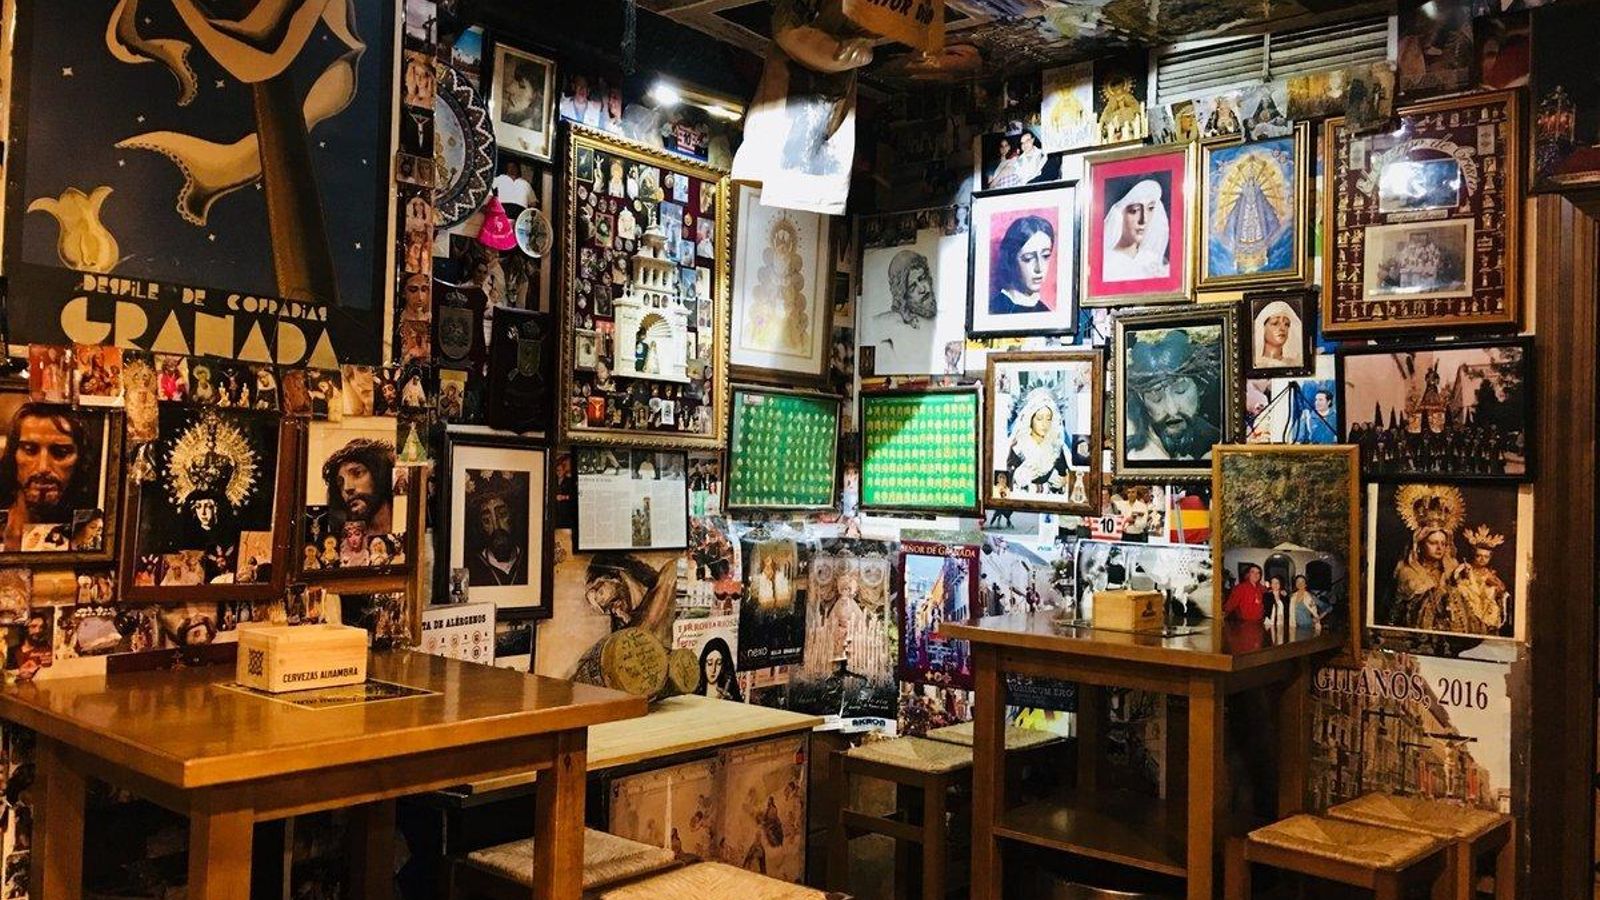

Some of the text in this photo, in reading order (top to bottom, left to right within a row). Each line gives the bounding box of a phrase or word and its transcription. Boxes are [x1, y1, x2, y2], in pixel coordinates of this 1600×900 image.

[182, 287, 206, 306] DE
[60, 296, 340, 370] GRANADA
[1100, 518, 1115, 534] 10
[926, 546, 937, 555] DE
[434, 619, 444, 630] DE
[283, 666, 359, 684] CERVEZAS ALHAMBRA
[1314, 666, 1488, 710] GITANOS, 2016
